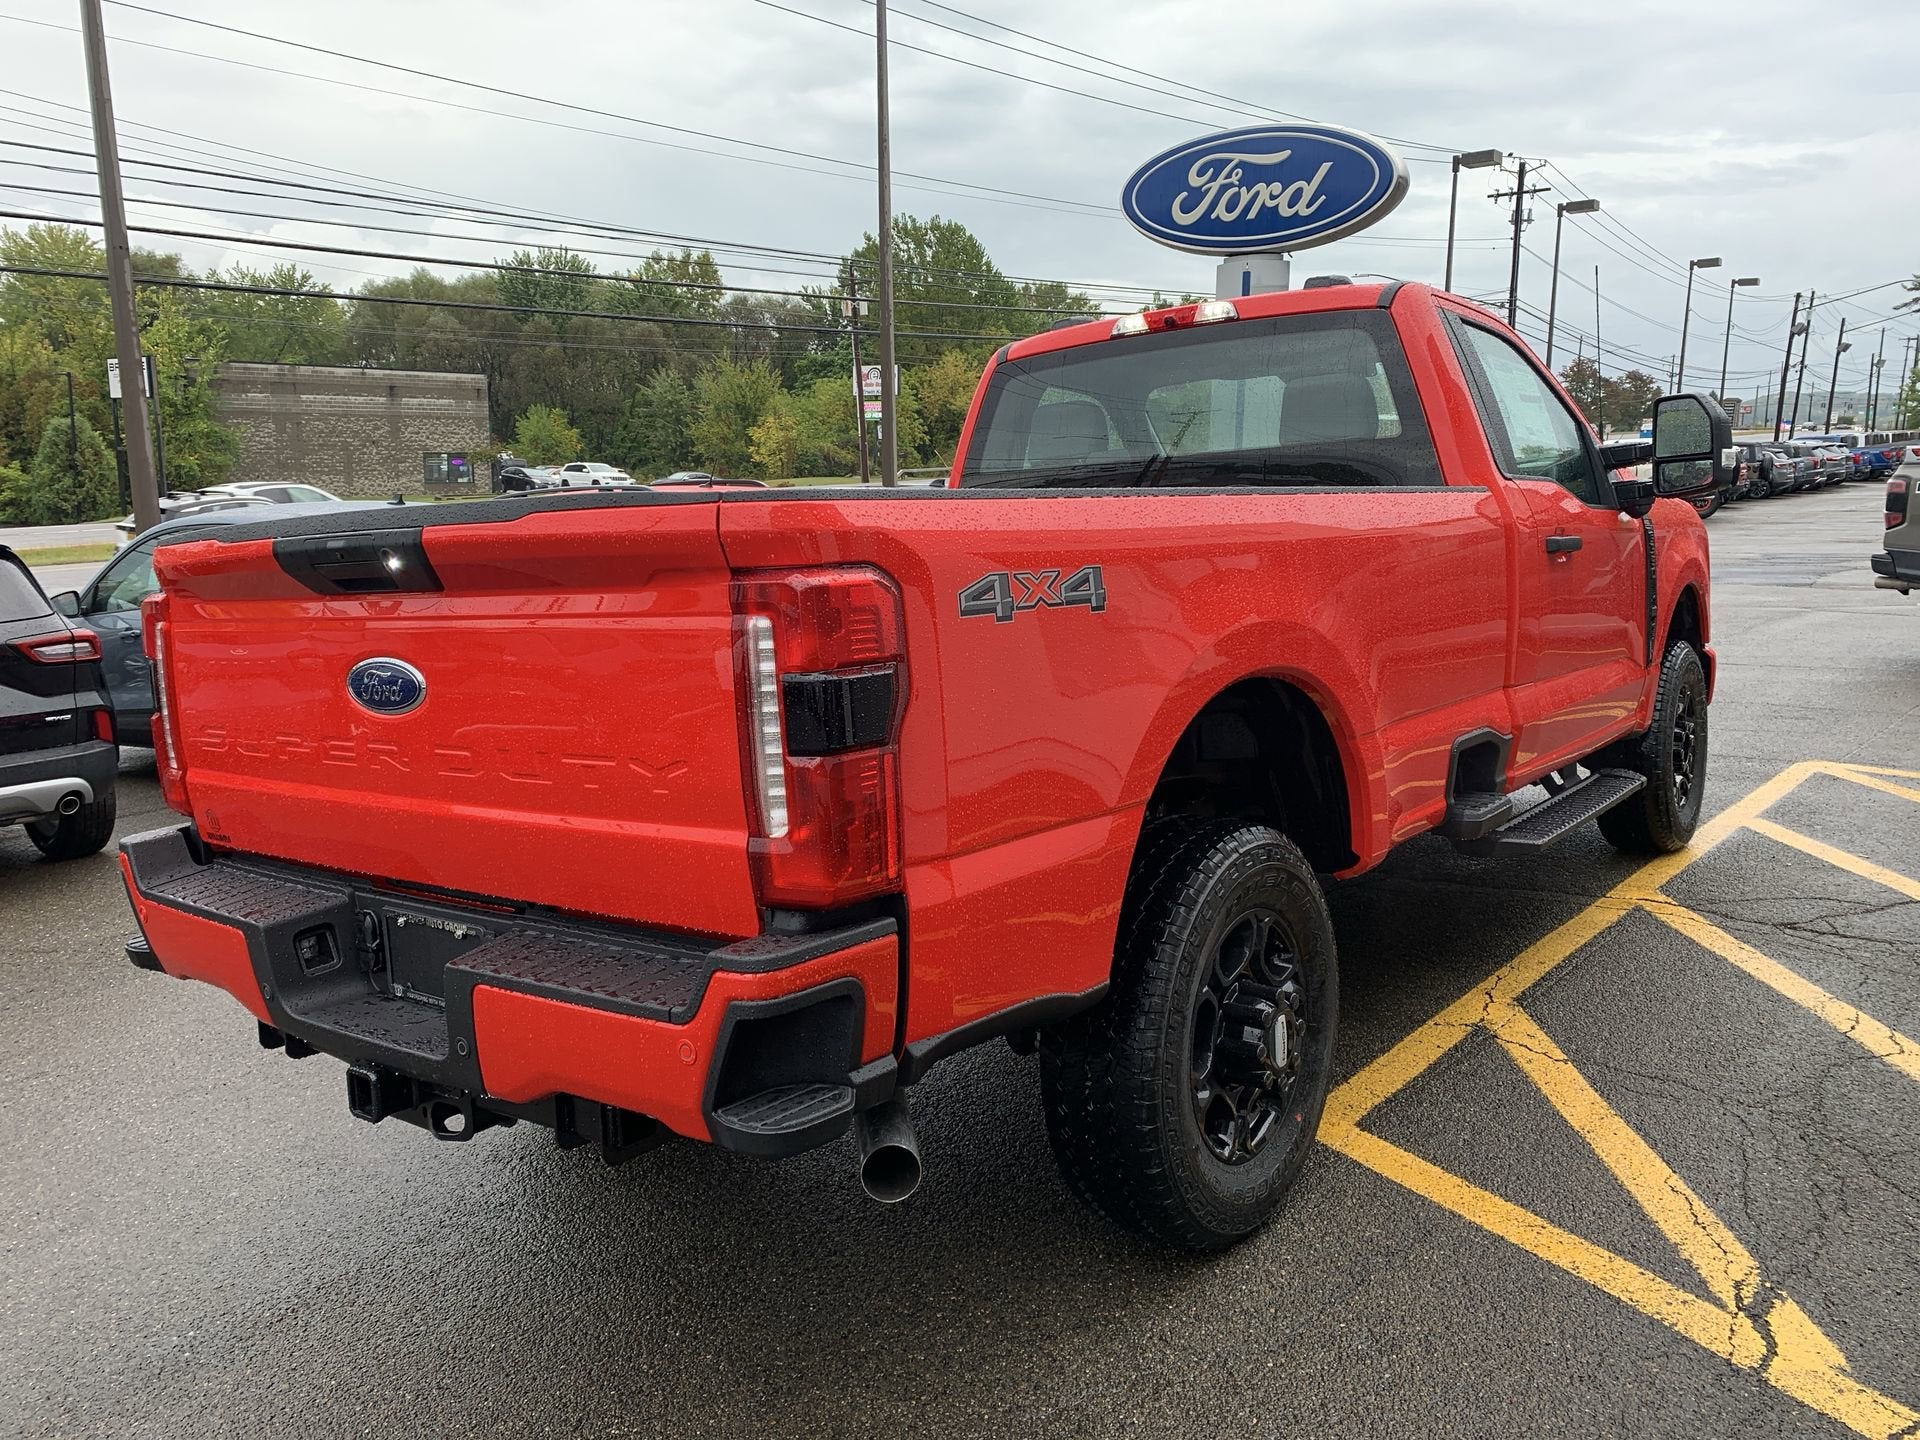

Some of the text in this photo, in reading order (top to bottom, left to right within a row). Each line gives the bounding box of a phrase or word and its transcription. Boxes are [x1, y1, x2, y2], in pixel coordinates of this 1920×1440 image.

[1171, 149, 1334, 226] Ford
[361, 669, 403, 701] Ford
[196, 726, 688, 793] SUPER DUTY
